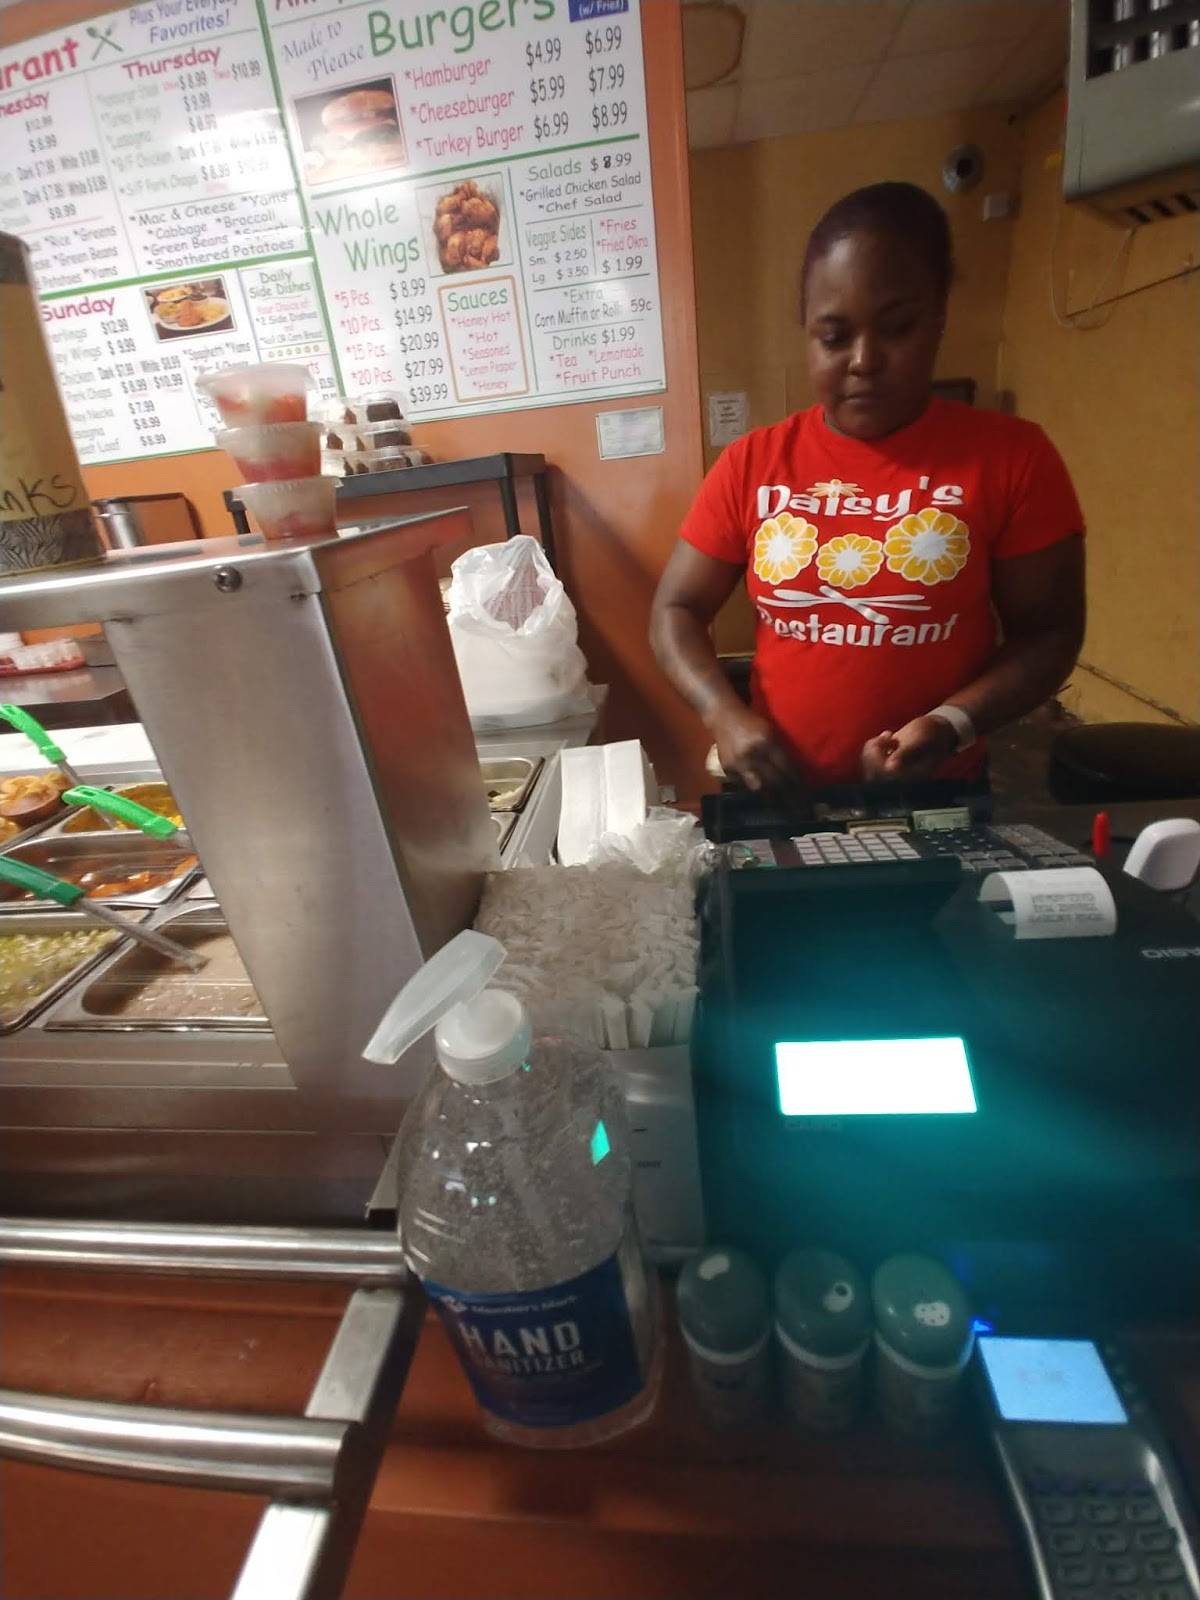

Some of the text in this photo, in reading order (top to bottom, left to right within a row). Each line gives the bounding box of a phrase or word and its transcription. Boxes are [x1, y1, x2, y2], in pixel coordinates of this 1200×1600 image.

[149, 8, 230, 44] Favorites!
[368, 0, 556, 57] Burgers
[281, 20, 344, 61] Made to
[525, 38, 562, 69] $4.99
[585, 25, 622, 58] $6.99
[121, 46, 221, 80] Thursday
[310, 44, 366, 80] Please
[529, 75, 566, 104] $5.99
[588, 63, 625, 98] $7.99
[476, 124, 524, 151] Burger
[533, 111, 570, 142] $6.99
[591, 101, 628, 133] $8.99
[527, 159, 582, 182] Salads
[564, 179, 608, 195] Chicken
[610, 171, 641, 189] Salad
[171, 208, 182, 221] &
[184, 200, 237, 219] Cheese
[584, 191, 622, 207] Salad
[315, 198, 400, 238] Whole
[191, 234, 229, 250] Beans
[231, 238, 295, 257] Potatoes
[525, 223, 586, 252] Veggie Sides
[89, 246, 119, 261] Beans
[343, 236, 421, 274] Wings
[528, 255, 547, 267] Sm
[259, 268, 293, 284] Daily
[531, 273, 545, 285] Lg
[249, 281, 312, 300] Side Dishes
[447, 287, 509, 313] Sauces
[40, 297, 115, 322] Sunday
[394, 304, 433, 329] $14.99
[491, 310, 512, 322] Hot
[533, 313, 556, 328] Corn
[556, 306, 588, 325] Muffin
[100, 317, 129, 335] $12.99
[552, 325, 636, 351] Drinks $1.99
[399, 331, 440, 357] $20.99
[404, 357, 444, 382] $27.99
[601, 363, 642, 381] Punch
[409, 383, 449, 407] $39.99
[757, 475, 965, 522] Daisy's
[458, 1320, 581, 1356] HAND
